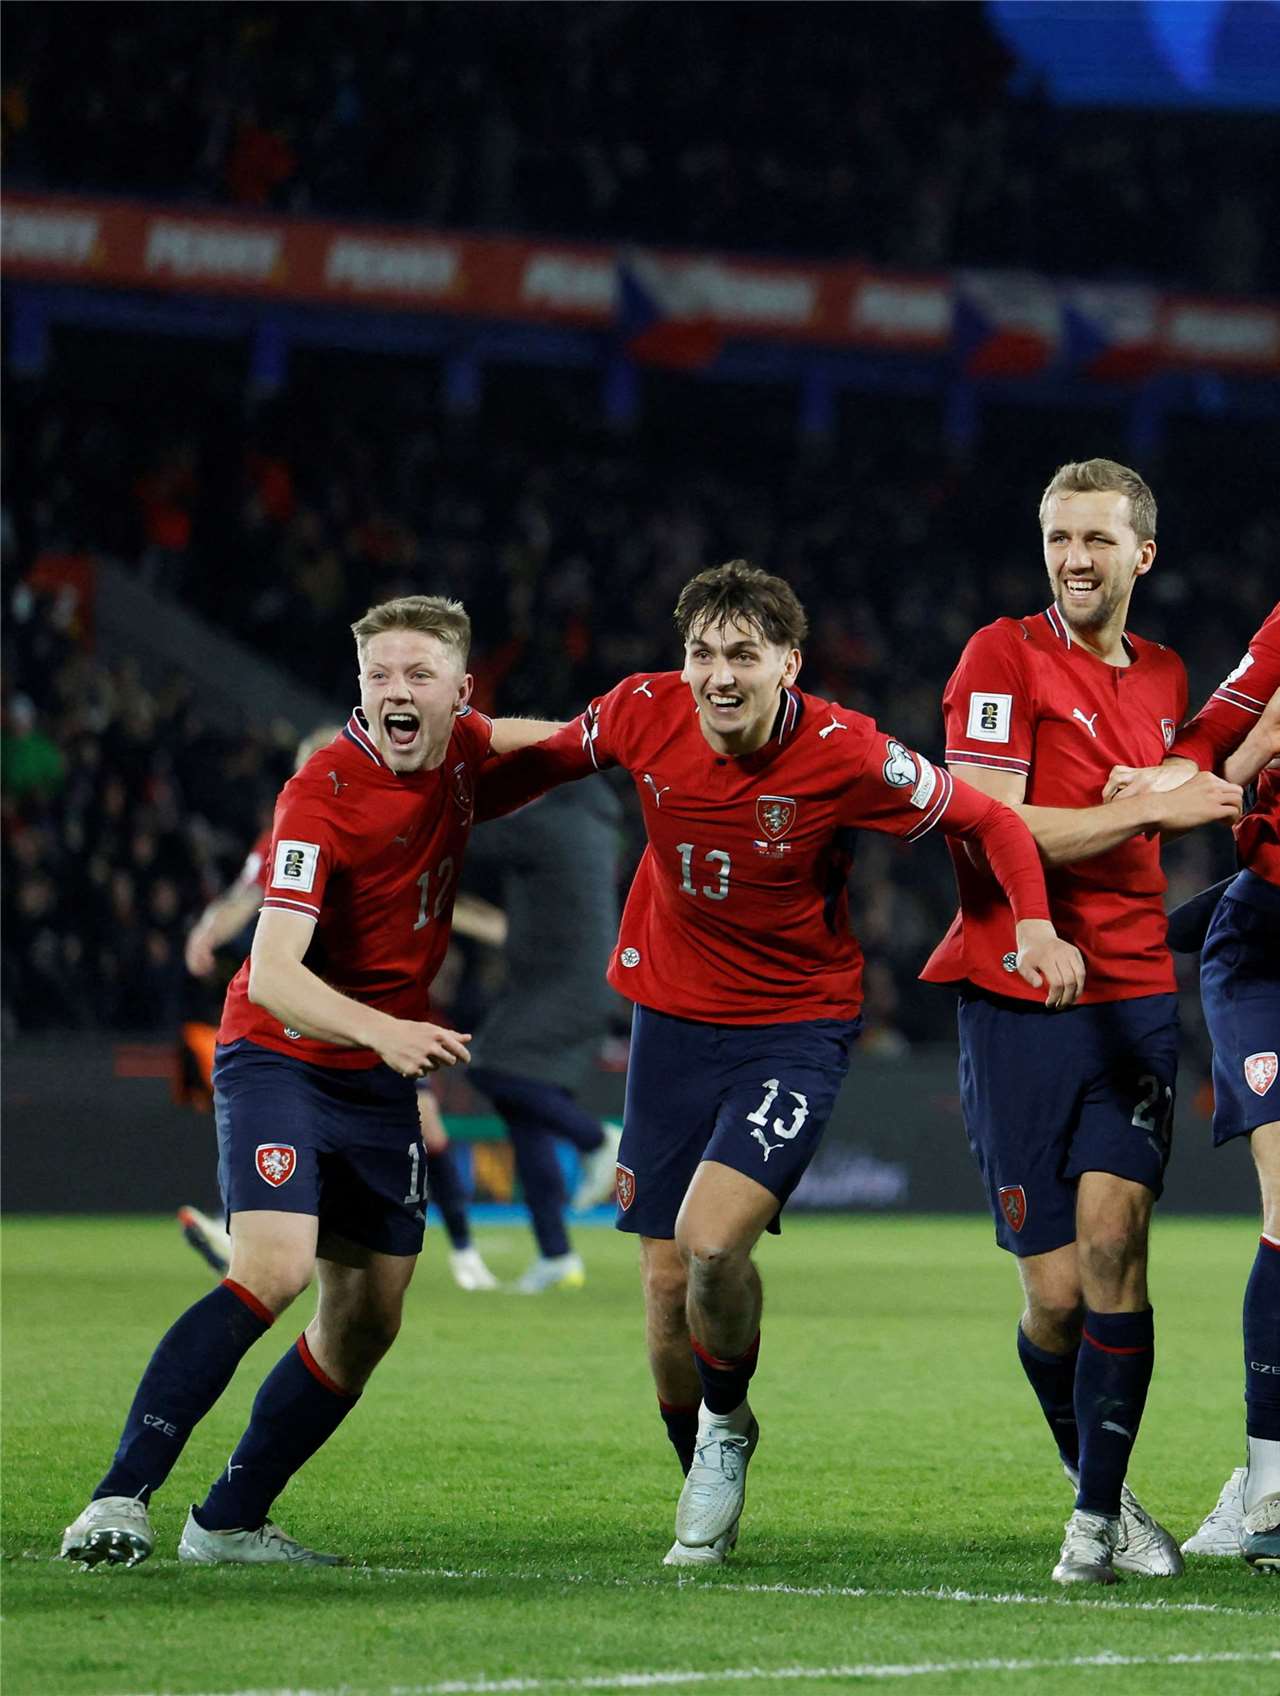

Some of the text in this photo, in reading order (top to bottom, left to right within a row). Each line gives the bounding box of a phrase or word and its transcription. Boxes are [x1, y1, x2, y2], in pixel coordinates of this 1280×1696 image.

[675, 842, 731, 901] 13
[746, 1078, 810, 1140] 13
[143, 1413, 177, 1438] CZE
